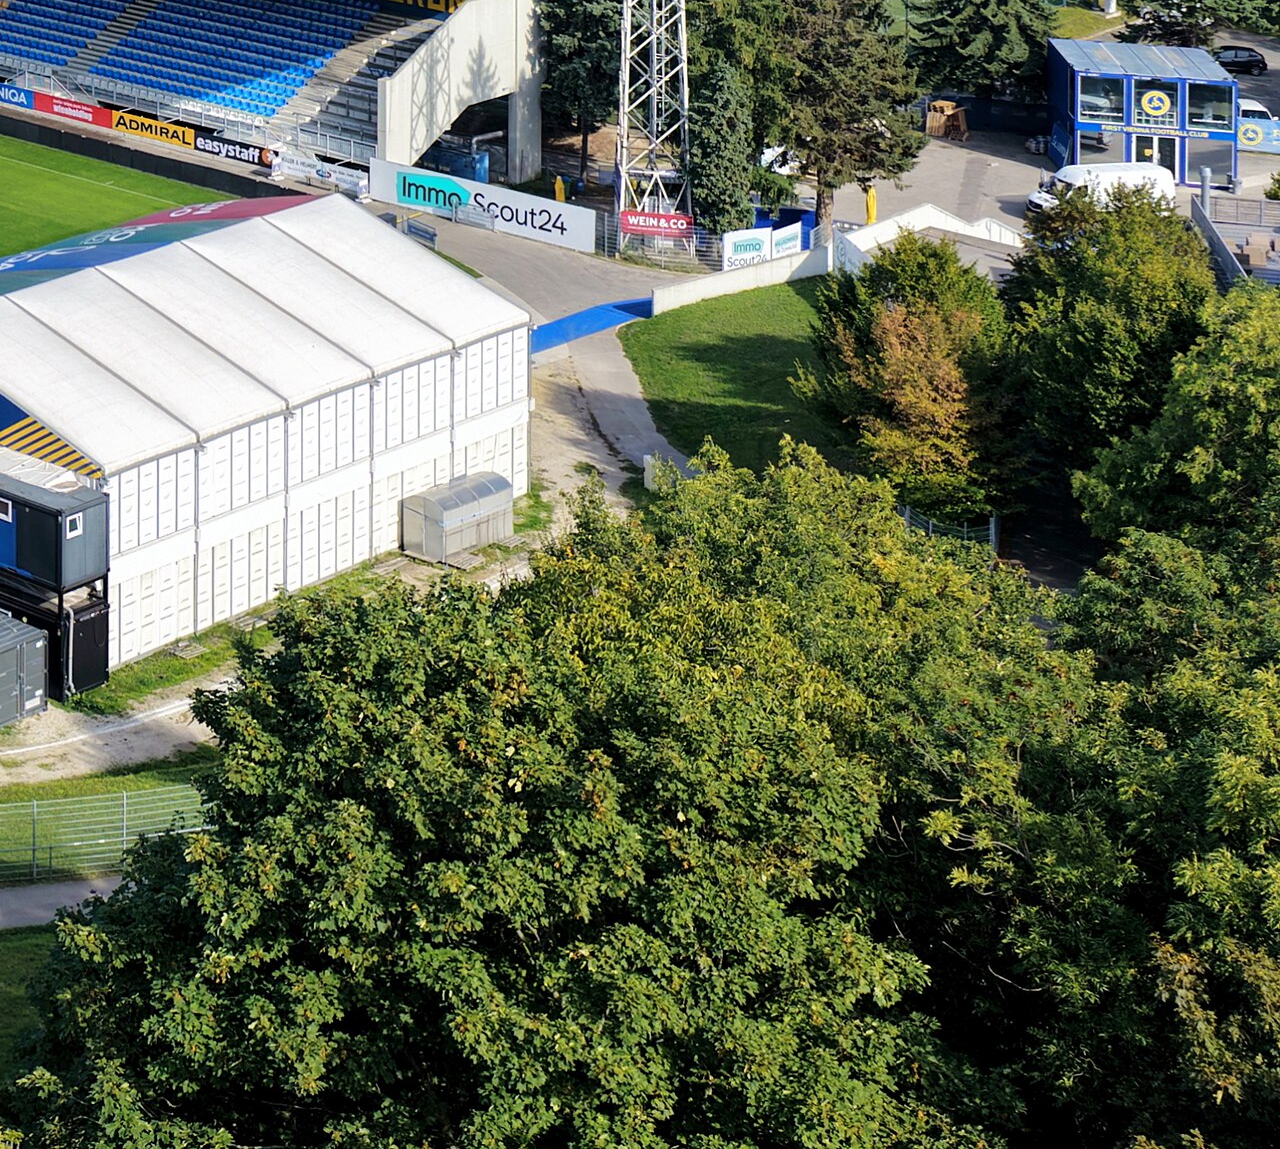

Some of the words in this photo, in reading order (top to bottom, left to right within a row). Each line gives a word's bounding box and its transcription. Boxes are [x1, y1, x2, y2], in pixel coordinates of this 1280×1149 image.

[115, 114, 192, 146] ADMIRAL
[1101, 124, 1122, 132] FIRST
[1123, 126, 1150, 135] VIENNA
[1150, 128, 1187, 137] FOOTBALL
[1187, 131, 1210, 139] CLUB
[196, 134, 260, 165] easystaff
[401, 175, 462, 208] Immo
[473, 192, 568, 236] Scout24
[627, 214, 659, 228] WEIN
[659, 218, 668, 228] &
[669, 219, 688, 230] CO
[733, 242, 762, 254] Immo
